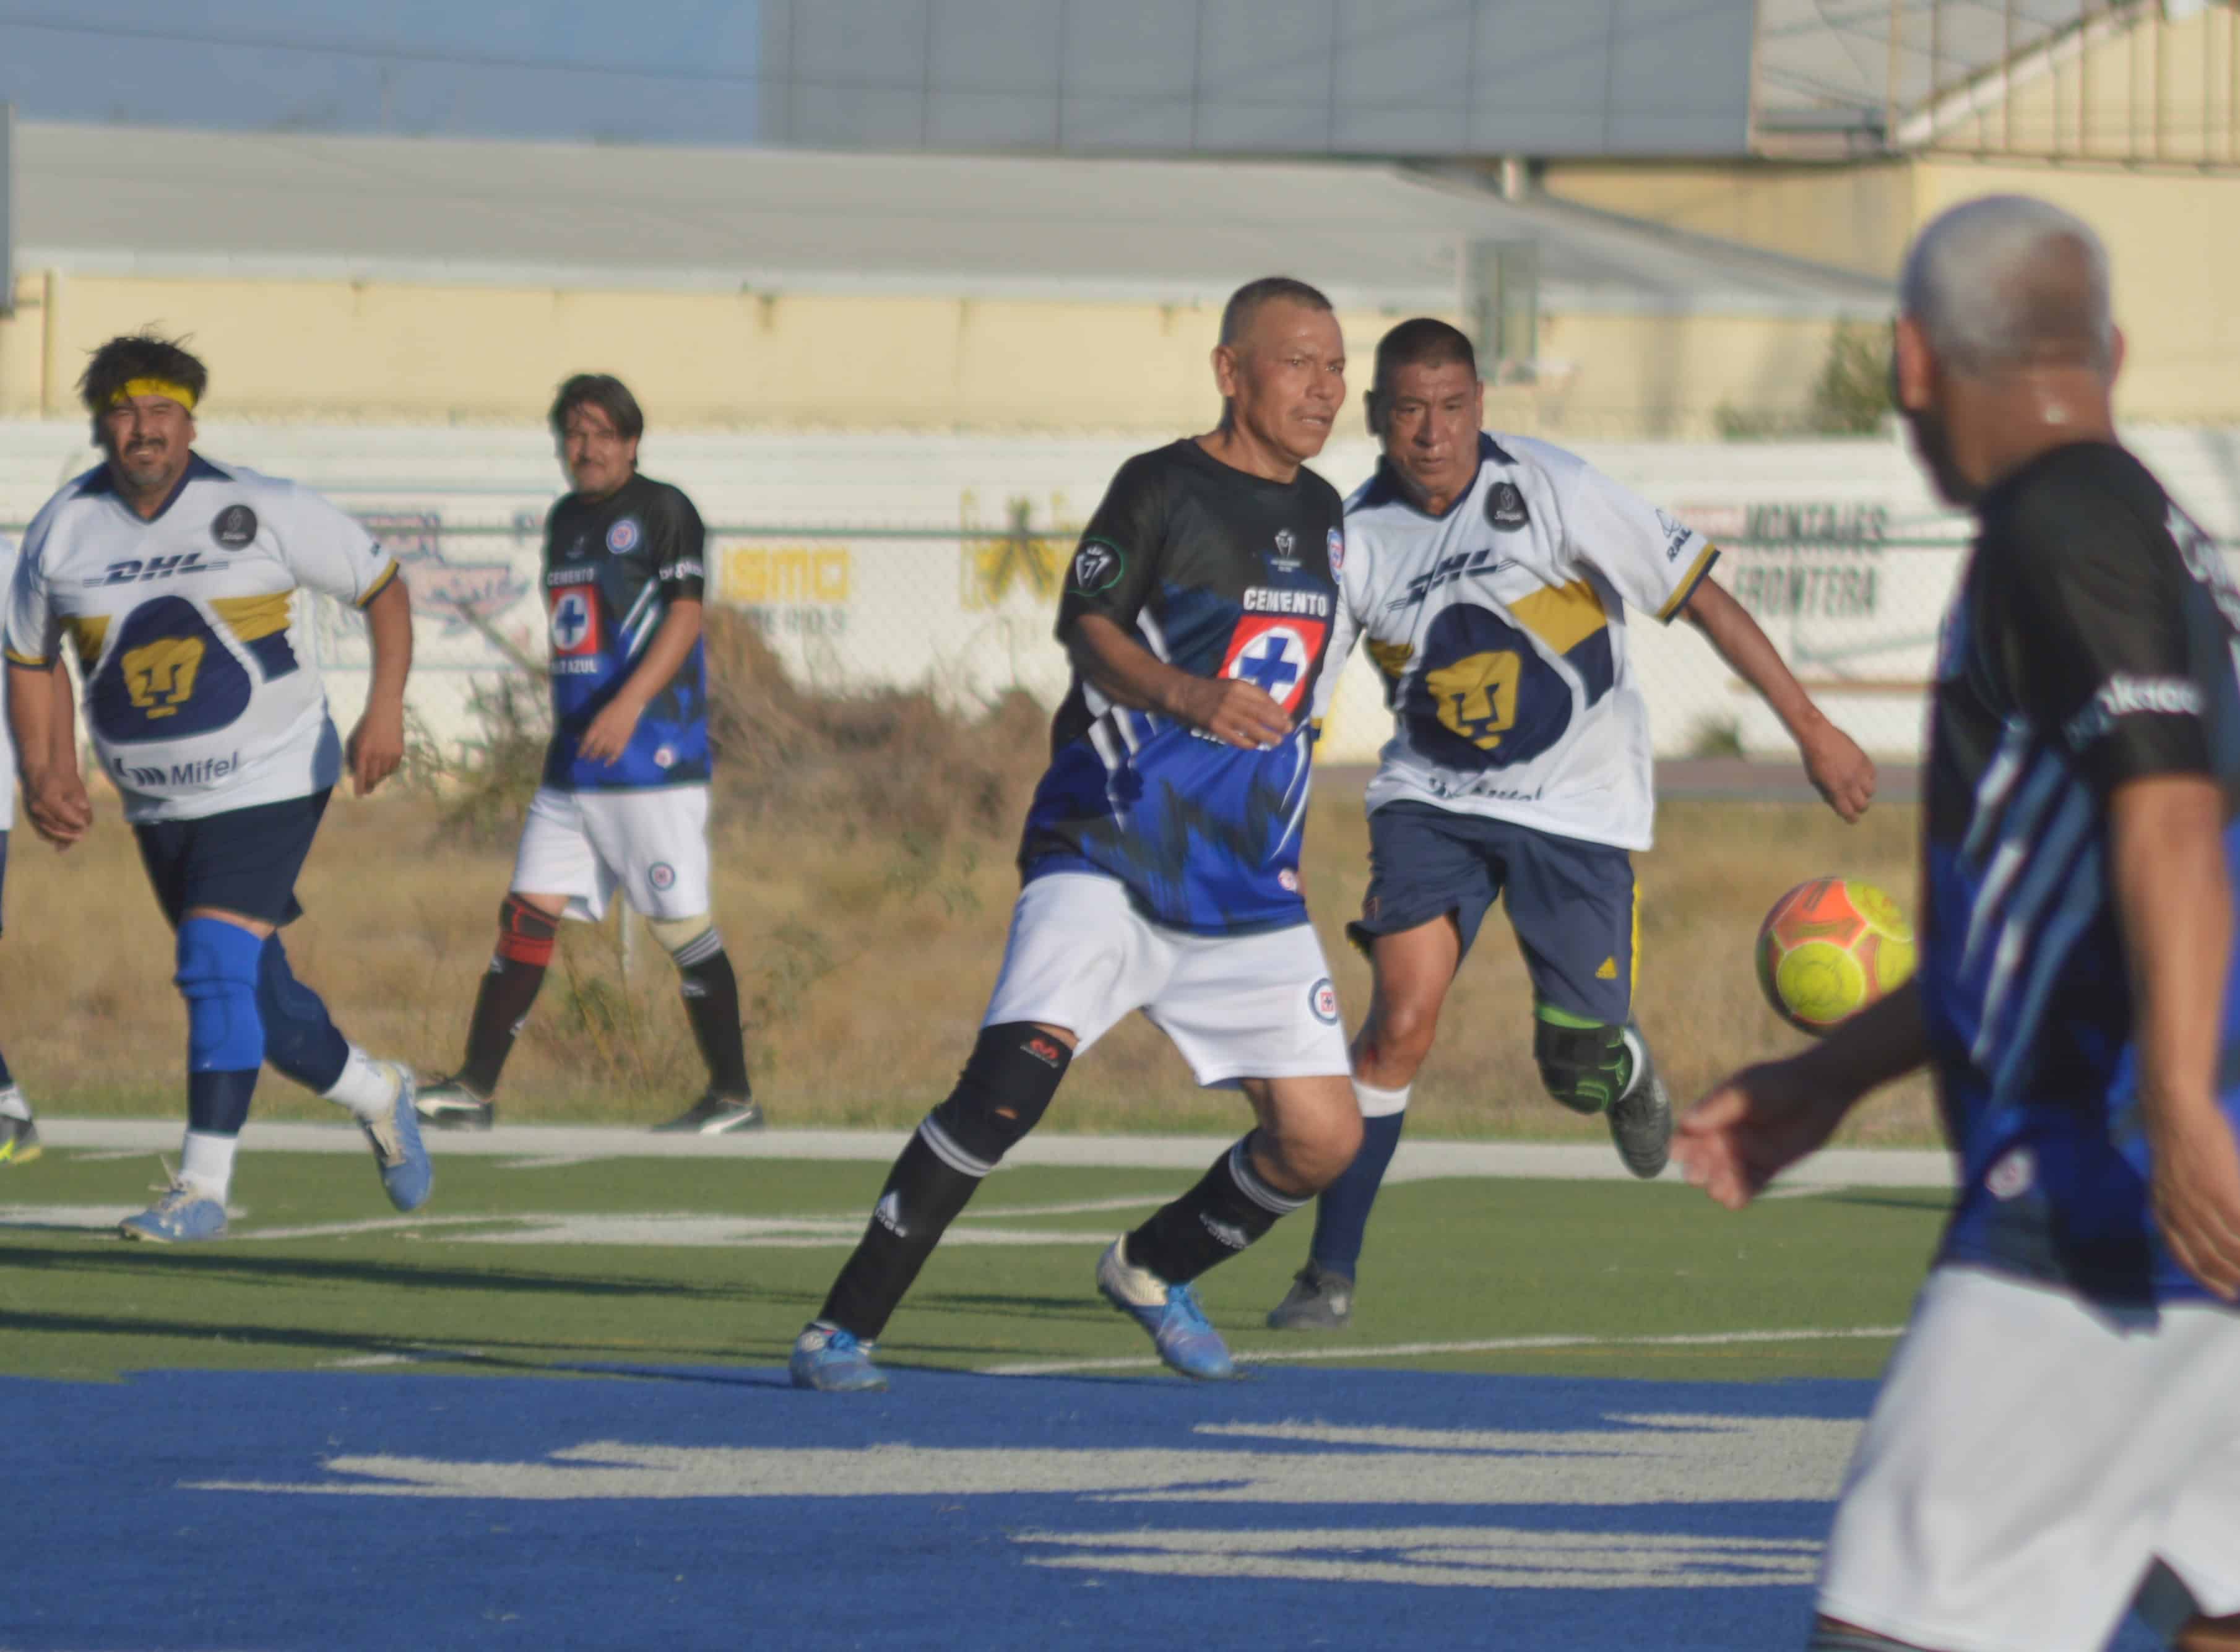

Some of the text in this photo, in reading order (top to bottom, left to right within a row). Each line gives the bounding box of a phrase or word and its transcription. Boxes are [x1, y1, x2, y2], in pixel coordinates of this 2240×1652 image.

[104, 553, 208, 586] DHL
[547, 566, 595, 586] CEMENTO
[1243, 587, 1328, 617] CEMENTO
[568, 659, 598, 674] AZUL
[171, 751, 239, 785] Mifel
